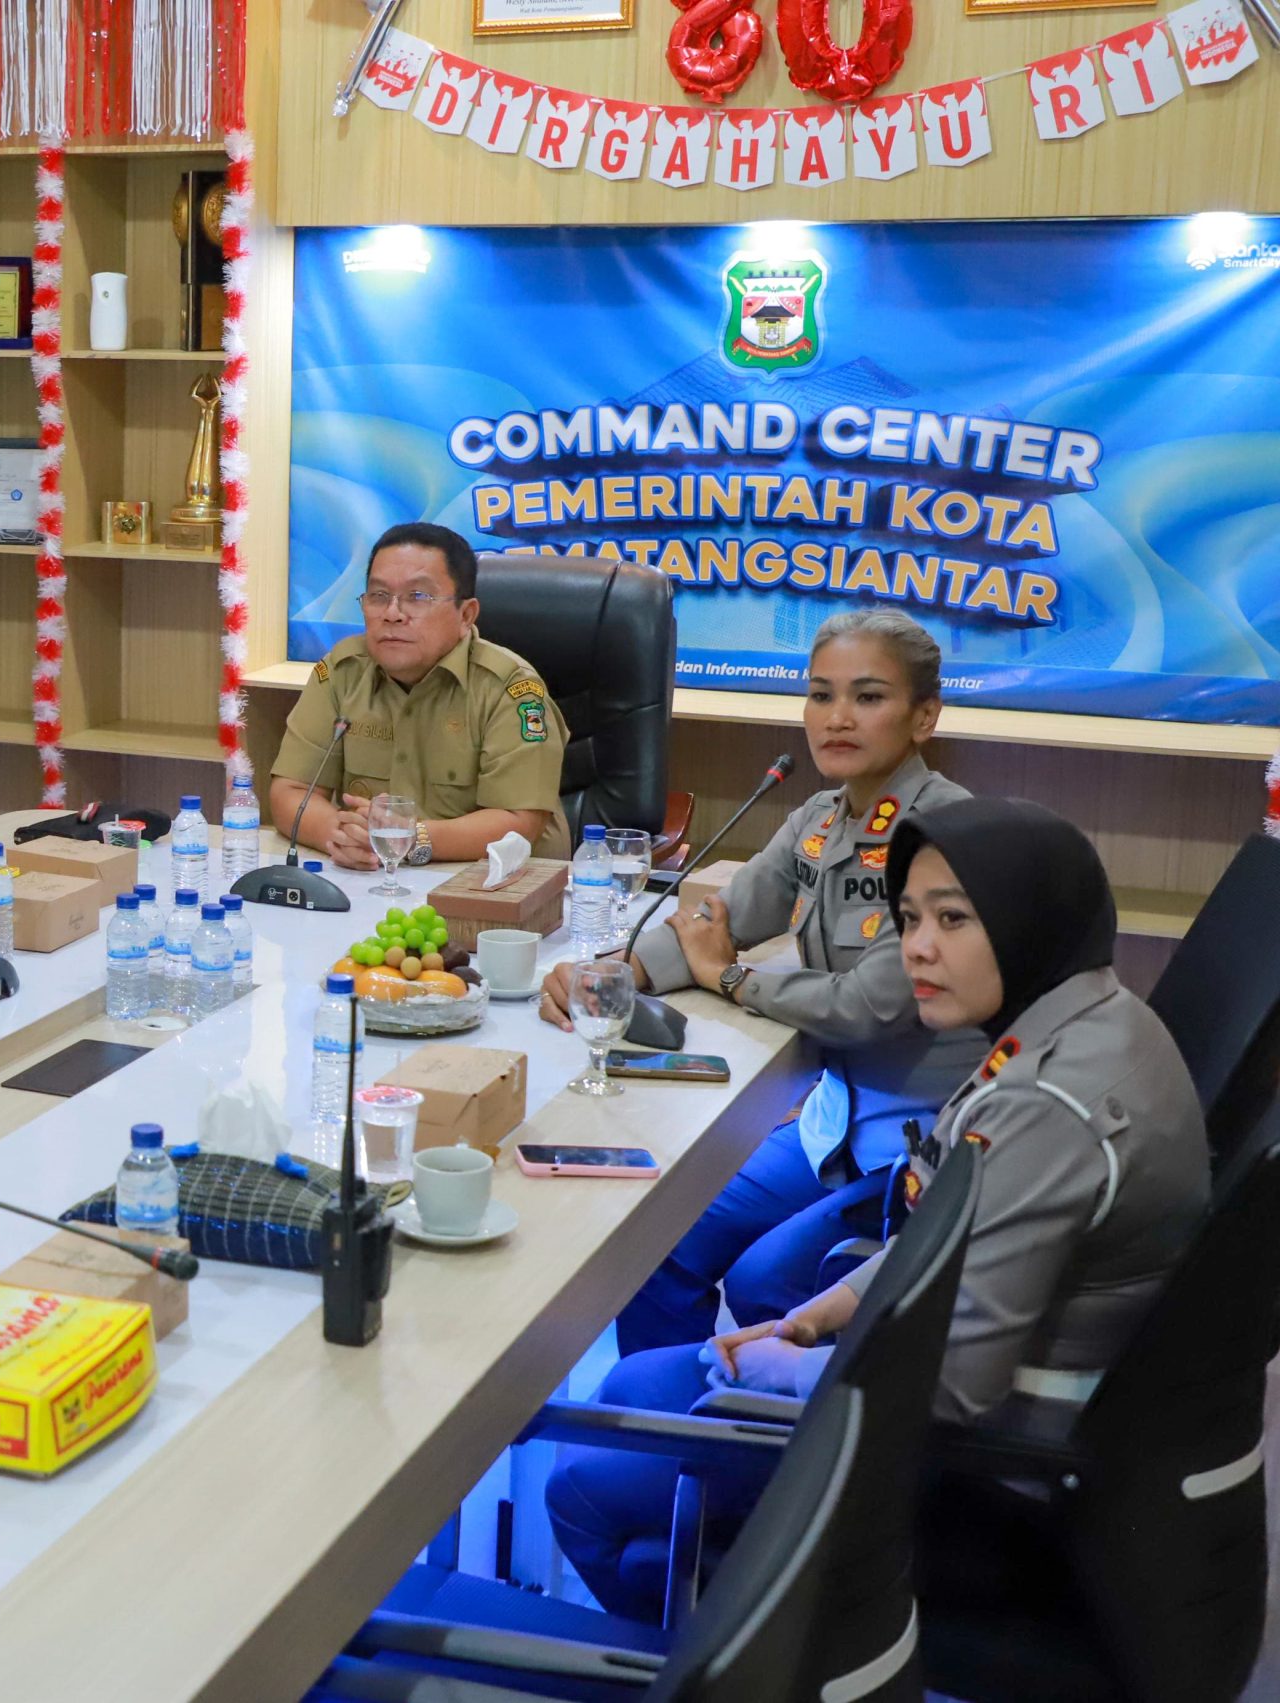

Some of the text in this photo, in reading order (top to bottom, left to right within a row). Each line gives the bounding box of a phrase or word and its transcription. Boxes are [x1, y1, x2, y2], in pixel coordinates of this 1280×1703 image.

[426, 81, 974, 183] DIRGAHAYU
[449, 403, 1100, 486] COMMAND CENTER
[474, 475, 1058, 552] PEMERINTAH KOTA
[480, 540, 1058, 620] TANGSIANTAR
[675, 660, 703, 674] dan
[705, 662, 799, 680] Informatika
[844, 877, 889, 901] POL
